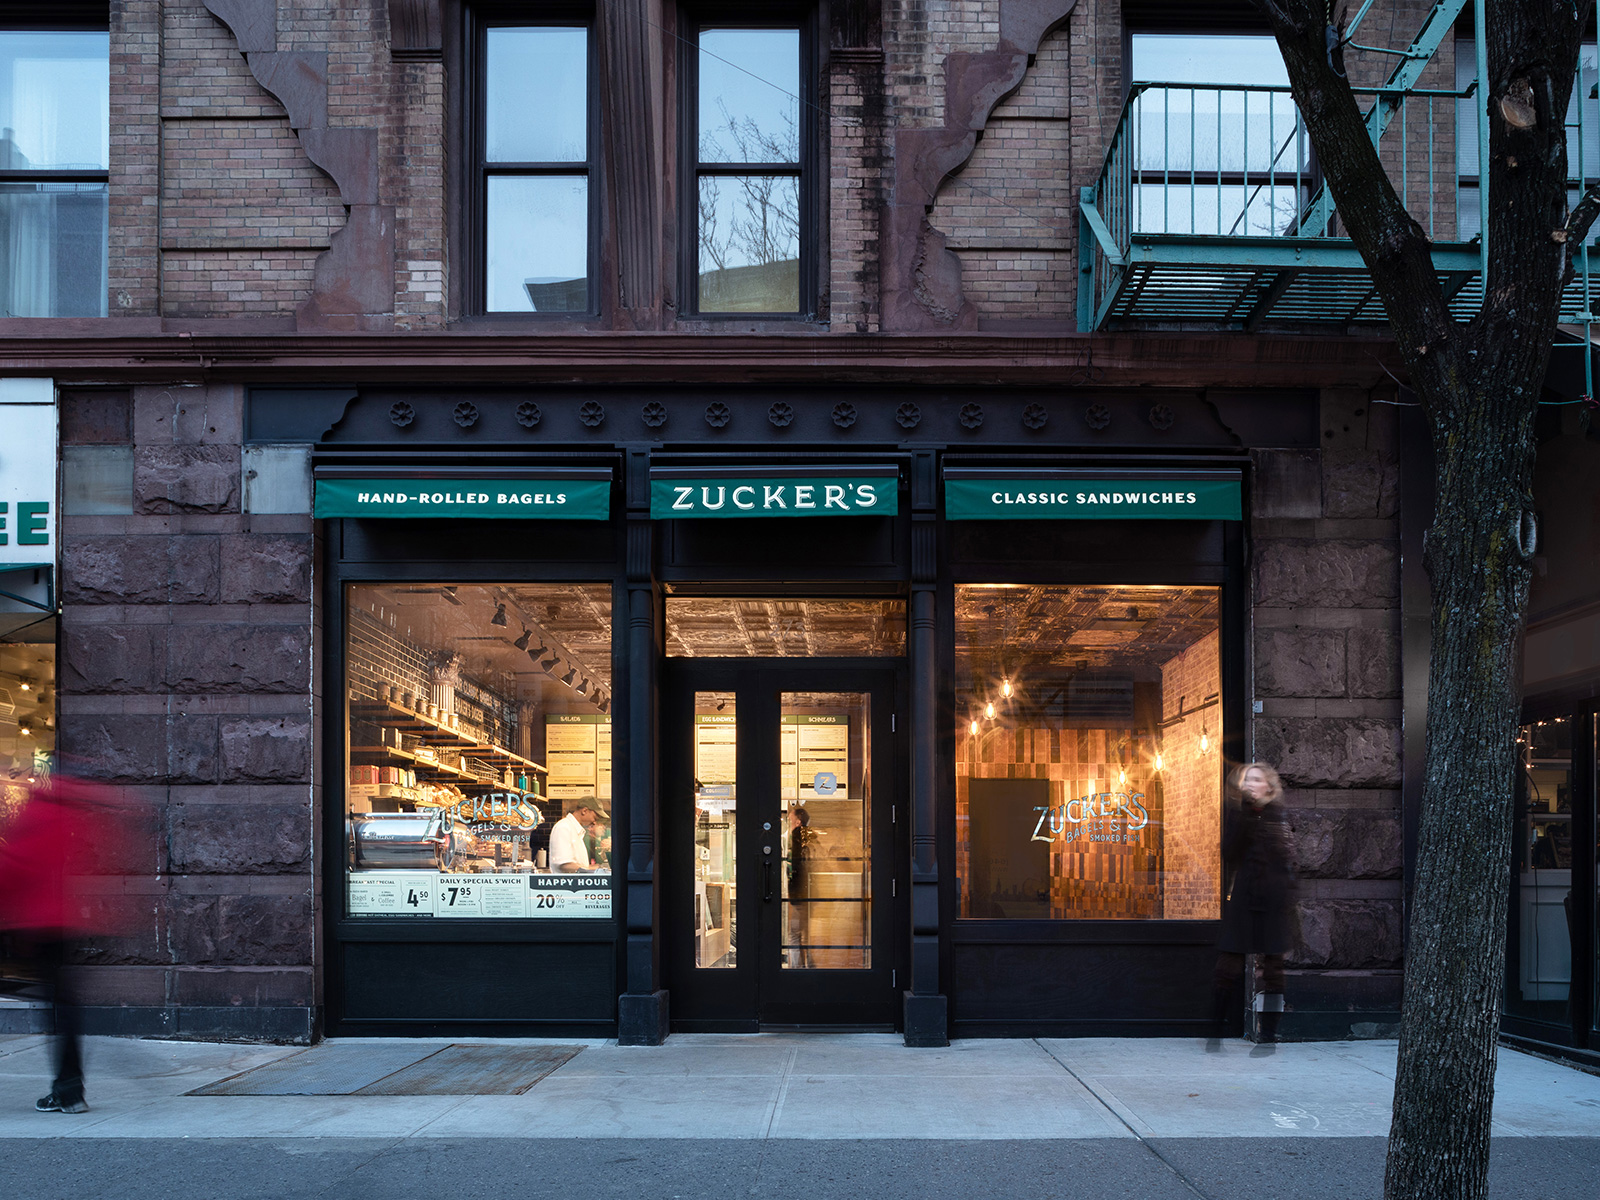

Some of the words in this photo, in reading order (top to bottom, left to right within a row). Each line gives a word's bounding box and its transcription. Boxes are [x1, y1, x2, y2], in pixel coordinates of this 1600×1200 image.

[357, 493, 490, 504] HAND-ROLLED
[496, 493, 567, 505] BAGELS
[671, 483, 878, 511] ZUCKER'S
[991, 492, 1070, 505] CLASSIC
[1075, 492, 1197, 505] SANDWICHES
[421, 790, 539, 844] ZUCKER'S
[1030, 788, 1149, 843] ZUCKER'S
[1066, 820, 1104, 843] BAGELS
[1109, 819, 1121, 831] &
[480, 834, 511, 842] SMOKED
[1089, 834, 1120, 842] SMOKED
[1123, 834, 1140, 842] FISH
[538, 878, 573, 886] HAPPY
[577, 878, 608, 886] HOUR
